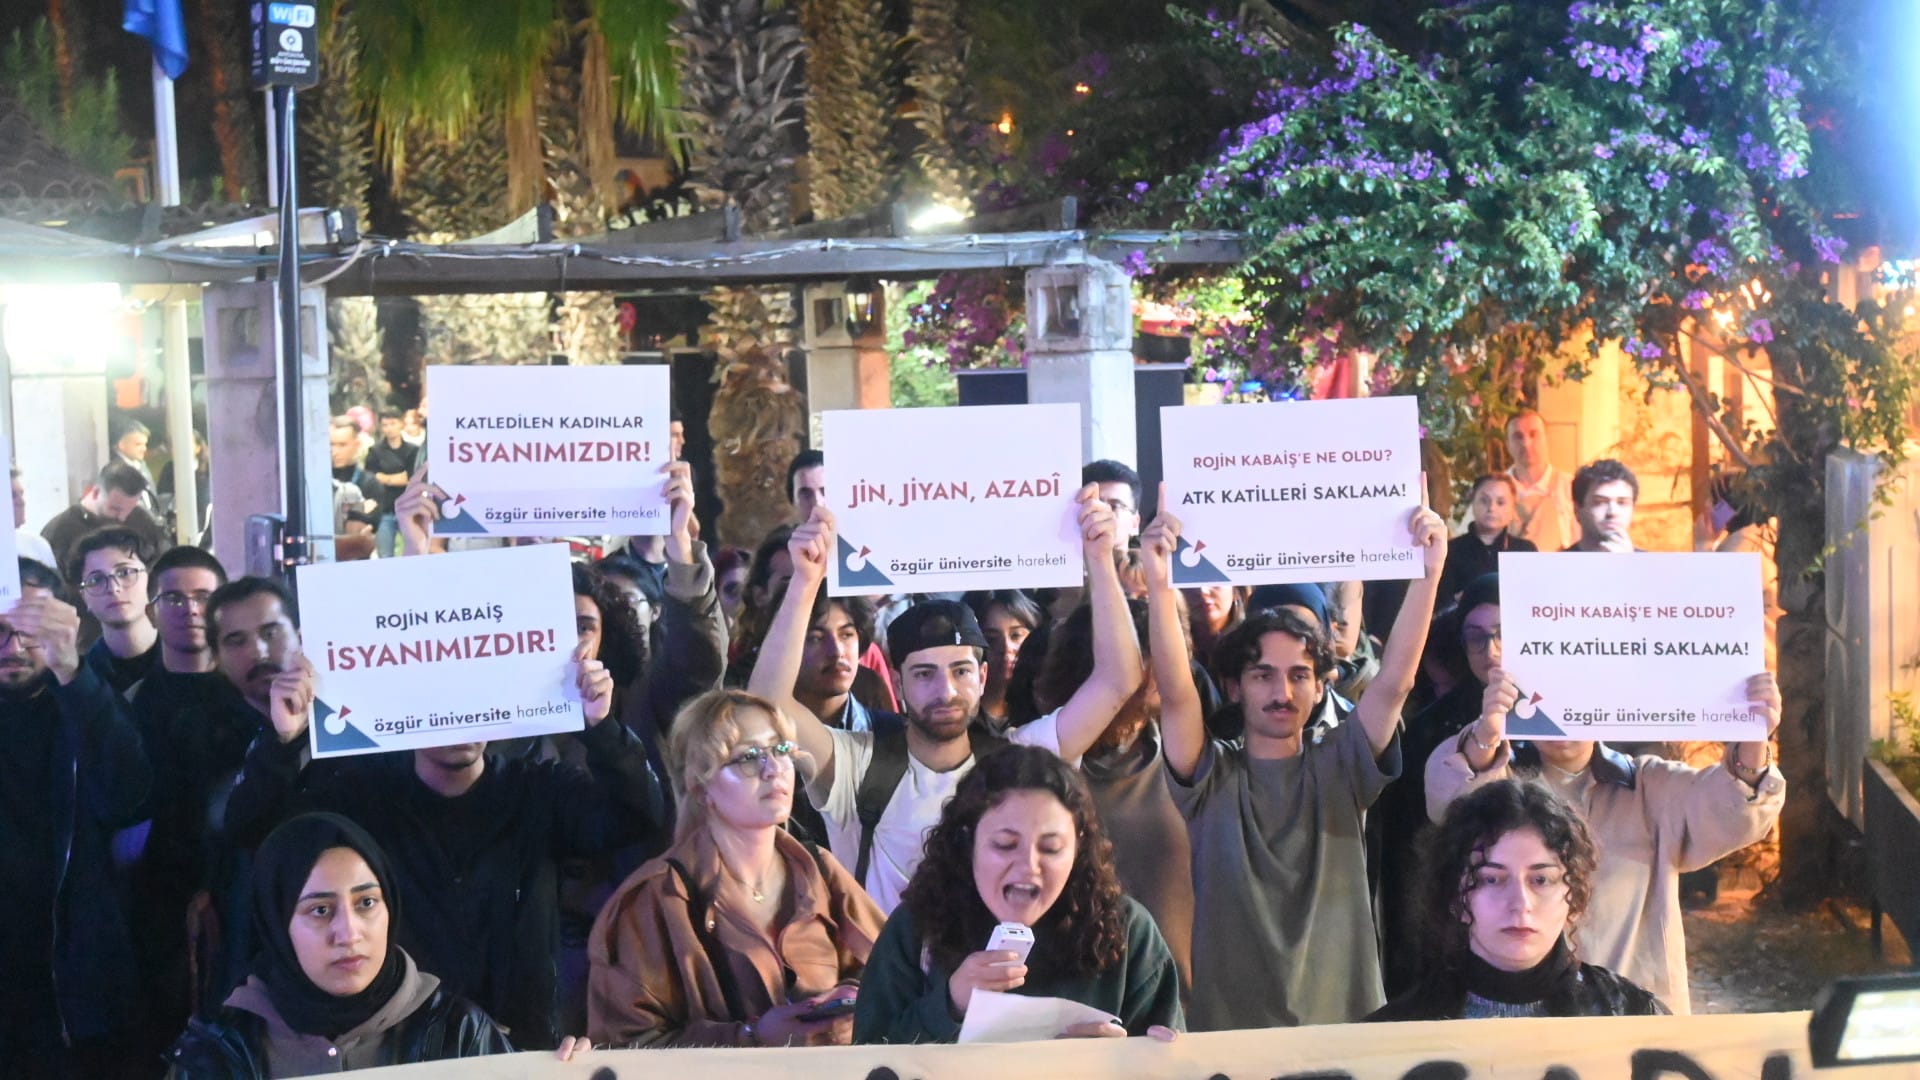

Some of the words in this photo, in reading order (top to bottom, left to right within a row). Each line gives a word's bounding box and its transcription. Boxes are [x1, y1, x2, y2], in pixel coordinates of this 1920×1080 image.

[456, 413, 554, 429] KATLEDİLEN
[560, 416, 644, 429] KADINLAR
[448, 436, 651, 463] İSYANIMIZDIR!
[1193, 452, 1236, 471] ROJİN
[1316, 451, 1337, 464] NE
[1342, 449, 1393, 463] OLDU?
[848, 478, 893, 509] JİN,
[899, 477, 976, 508] JİYAN,
[985, 472, 1061, 498] AZADÎ
[1181, 491, 1216, 505] ATK
[1221, 483, 1307, 504] KATİLLERİ
[1313, 483, 1407, 500] SAKLAMA!
[485, 508, 528, 523] özgür
[533, 507, 607, 519] üniversite
[611, 506, 660, 519] hareketi
[890, 558, 934, 575] özgür
[939, 555, 1012, 570] üniversite
[1017, 552, 1066, 568] hareketi
[1226, 554, 1272, 571] özgür
[1277, 550, 1355, 566] üniversite
[1360, 548, 1413, 563] hareketi
[376, 608, 429, 631] ROJİN
[435, 602, 504, 624] KABAİŞ
[1531, 603, 1576, 621] ROJİN
[1657, 606, 1678, 618] NE
[1683, 605, 1735, 618] OLDU?
[327, 628, 556, 672] İSYANIMIZDIR!
[1519, 641, 1554, 656] ATK
[1560, 637, 1647, 655] KATİLLERİ
[1653, 640, 1749, 656] SAKLAMA!
[374, 716, 422, 734] özgür
[429, 708, 512, 727] üniversite
[516, 700, 571, 718] hareketi
[1563, 708, 1611, 726] özgür
[1616, 708, 1696, 722] üniversite
